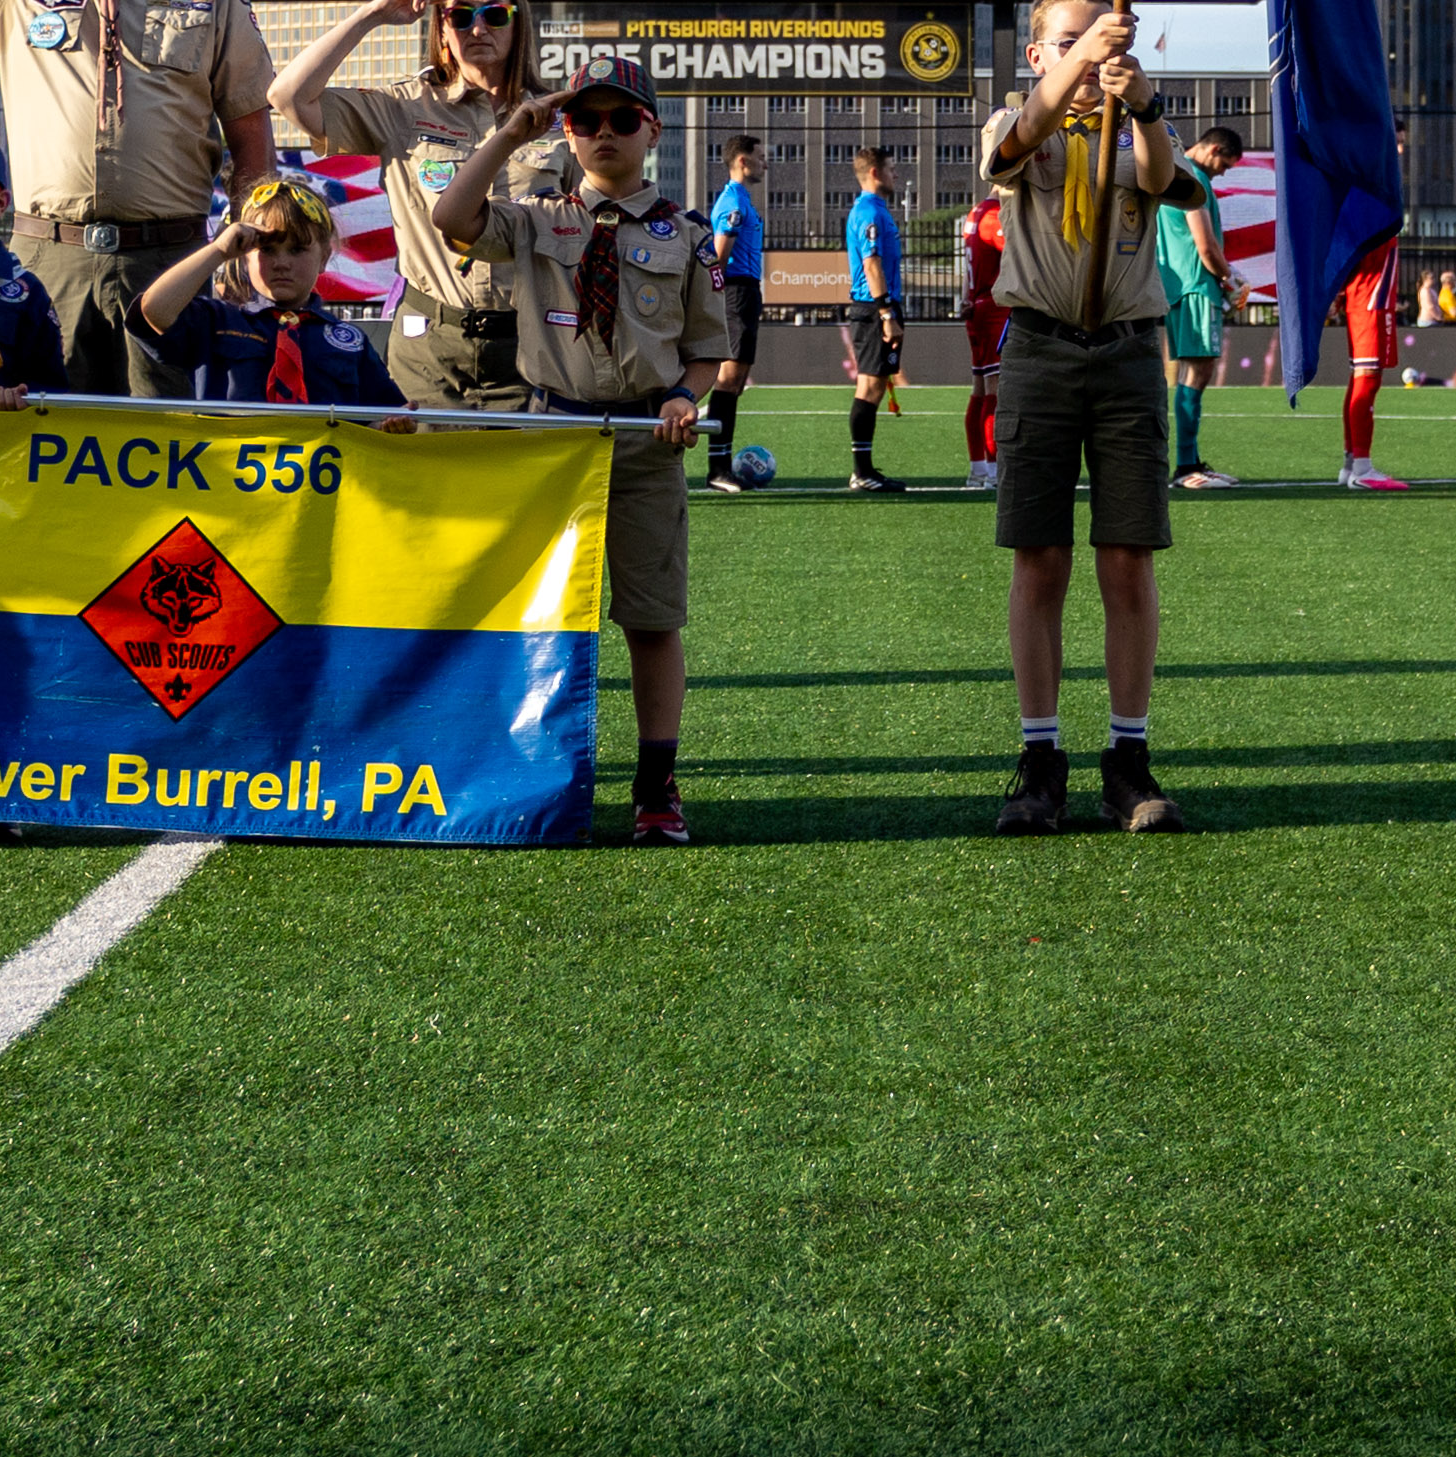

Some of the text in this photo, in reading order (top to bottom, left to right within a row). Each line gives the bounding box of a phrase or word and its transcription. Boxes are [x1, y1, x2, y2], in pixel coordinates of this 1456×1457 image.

[626, 20, 886, 38] PITTSBURGH RIVERHOUNDS
[650, 44, 886, 79] CHAMPIONS
[27, 432, 343, 495] PACK 556
[744, 452, 768, 474] SELECT
[125, 641, 236, 671] CUB SCOUTS
[105, 752, 336, 821] Burrell,
[360, 762, 448, 816] PA
